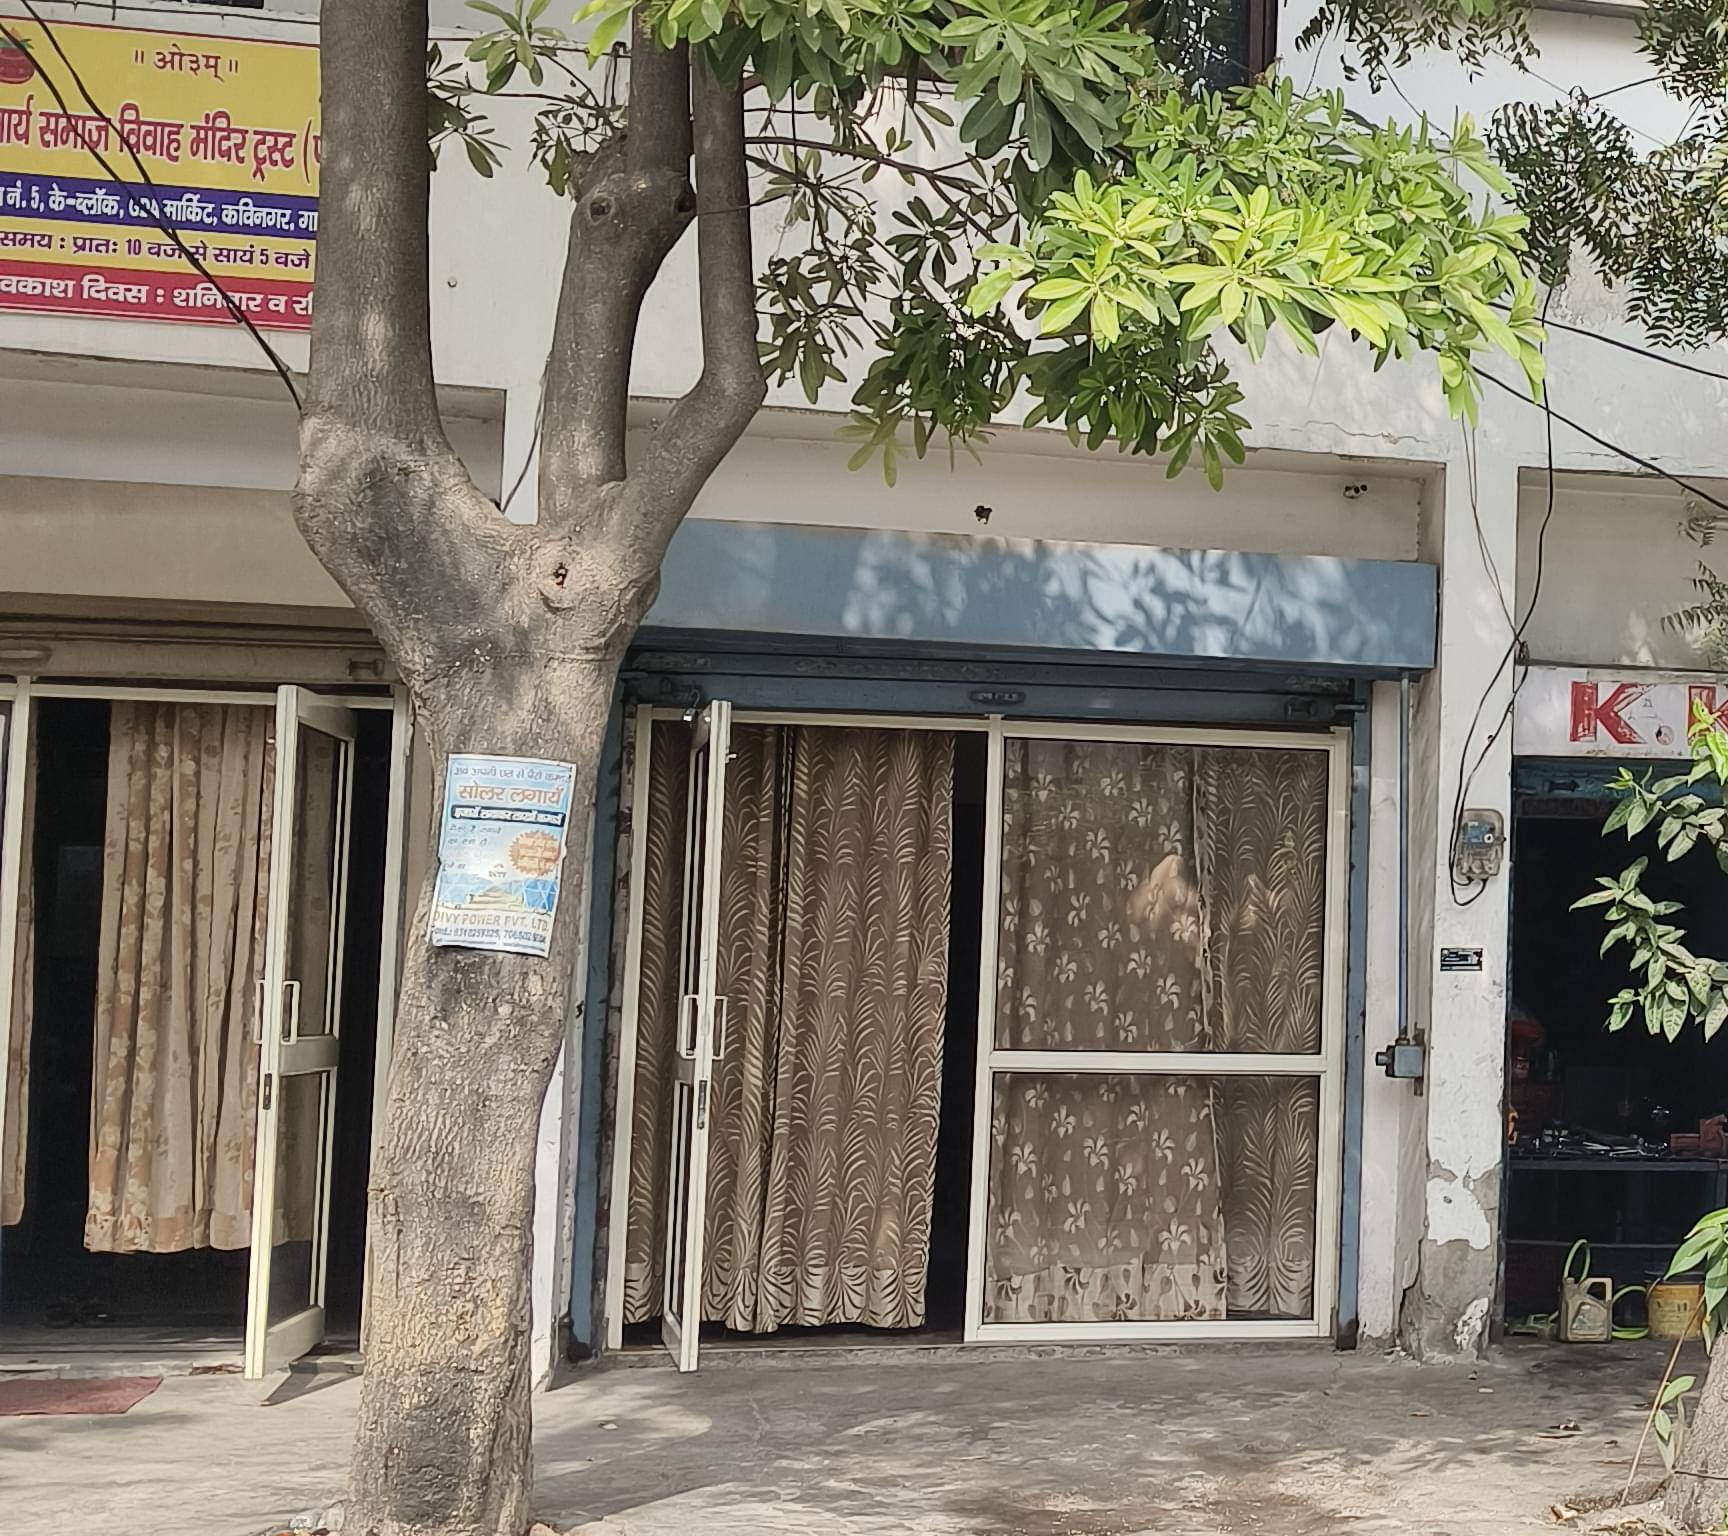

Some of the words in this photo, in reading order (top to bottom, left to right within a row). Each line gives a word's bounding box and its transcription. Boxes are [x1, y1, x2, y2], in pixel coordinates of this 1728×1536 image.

[38, 111, 112, 152] समाज
[118, 102, 185, 163] विवाह
[189, 110, 249, 164] मंदिर
[252, 129, 297, 182] ट्रस्ट
[31, 185, 45, 213] 5,
[162, 192, 218, 226] मार्किट,
[0, 230, 53, 250] समय
[72, 236, 118, 255] प्रातः
[126, 238, 142, 256] 10
[146, 241, 183, 260] वज
[189, 239, 208, 262] से
[212, 243, 256, 265] सायं
[259, 248, 269, 265] 5
[274, 248, 312, 269] वजे
[0, 274, 76, 299] वकाश
[80, 273, 150, 305] दिवस
[267, 294, 288, 314] व
[458, 780, 506, 802] सोलर
[462, 913, 501, 927] POWER
